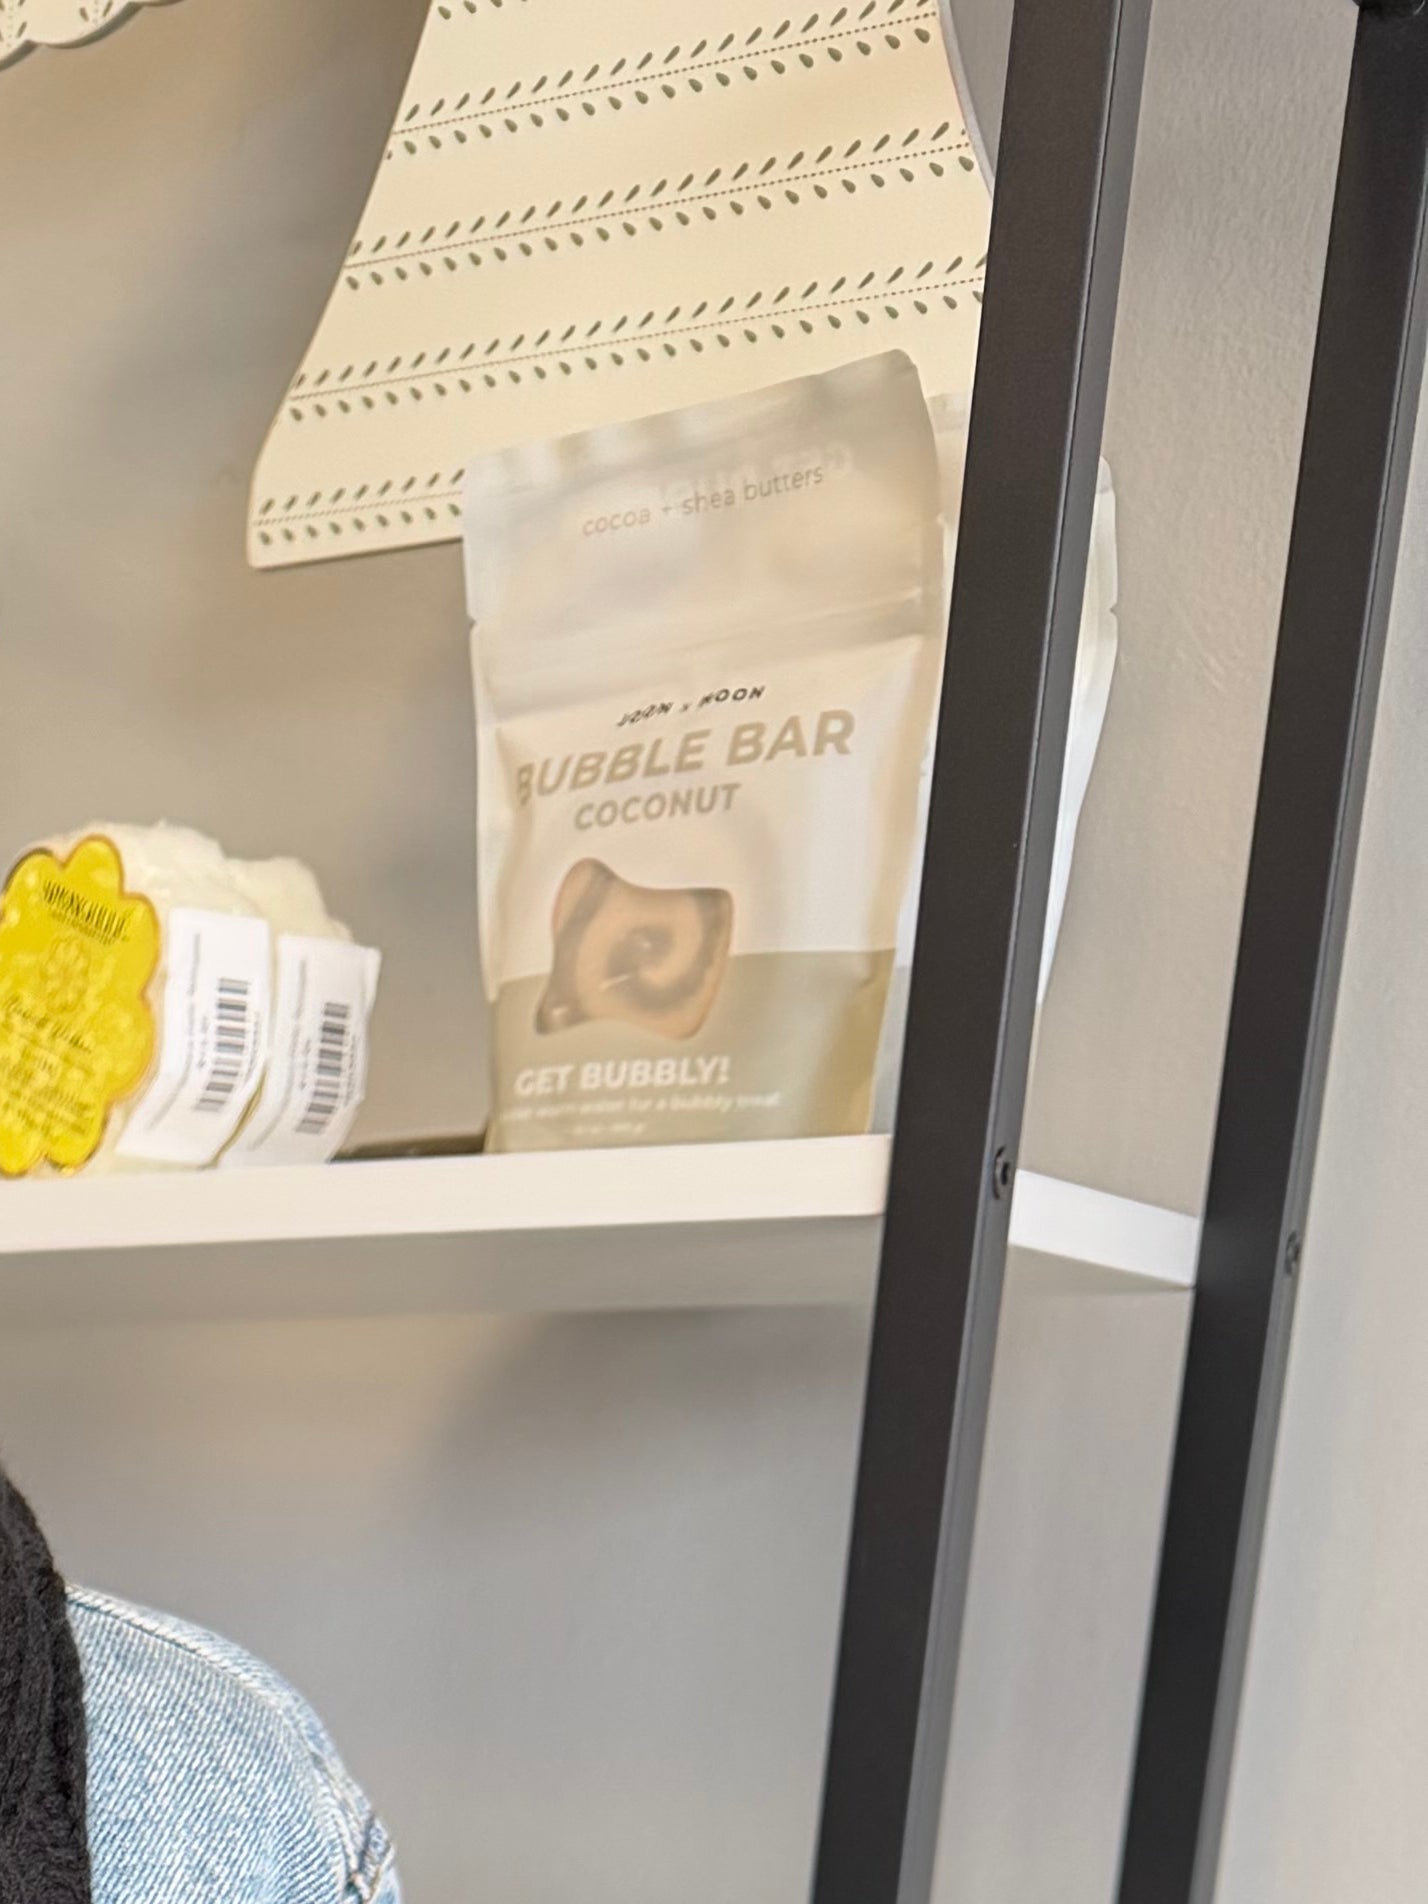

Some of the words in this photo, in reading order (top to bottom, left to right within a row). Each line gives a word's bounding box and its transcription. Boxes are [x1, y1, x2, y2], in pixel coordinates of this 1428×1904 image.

[582, 507, 651, 538] cocoa
[681, 488, 736, 517] shea
[744, 465, 825, 502] butters
[516, 728, 713, 808] BUBBLE
[725, 708, 857, 767] BAR
[572, 782, 742, 832] COCONUT
[513, 1064, 575, 1098] GET
[578, 1055, 732, 1092] BUBBLY!
